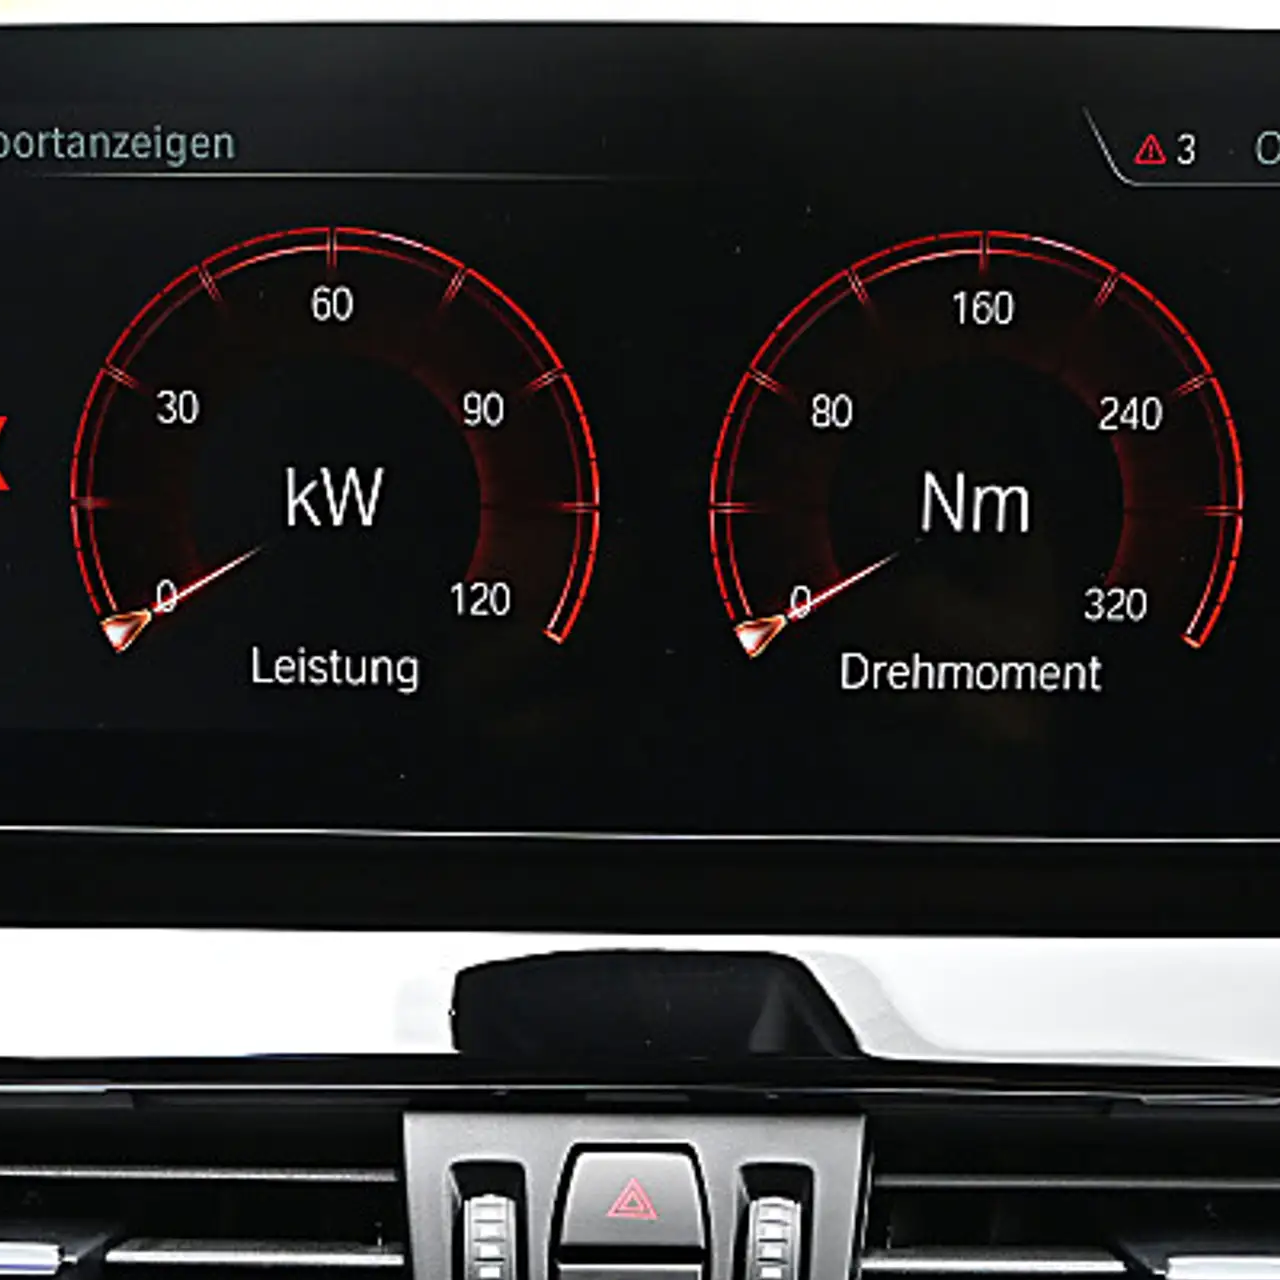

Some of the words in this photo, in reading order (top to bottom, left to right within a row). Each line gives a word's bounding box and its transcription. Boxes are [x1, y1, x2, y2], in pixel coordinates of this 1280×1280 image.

[1176, 134, 1197, 165] 3
[312, 288, 353, 321] 60
[954, 292, 1014, 325] 160
[157, 391, 198, 425] 30
[463, 392, 504, 427] 90
[811, 396, 853, 429] 80
[1099, 398, 1162, 431] 240
[286, 468, 384, 528] kW
[922, 472, 1029, 533] Nm
[155, 580, 178, 613] 0
[451, 582, 511, 617] 120
[790, 586, 812, 618] 0
[1084, 589, 1147, 622] 320
[251, 648, 419, 693] Leistung
[841, 654, 1101, 692] Drehmoment
